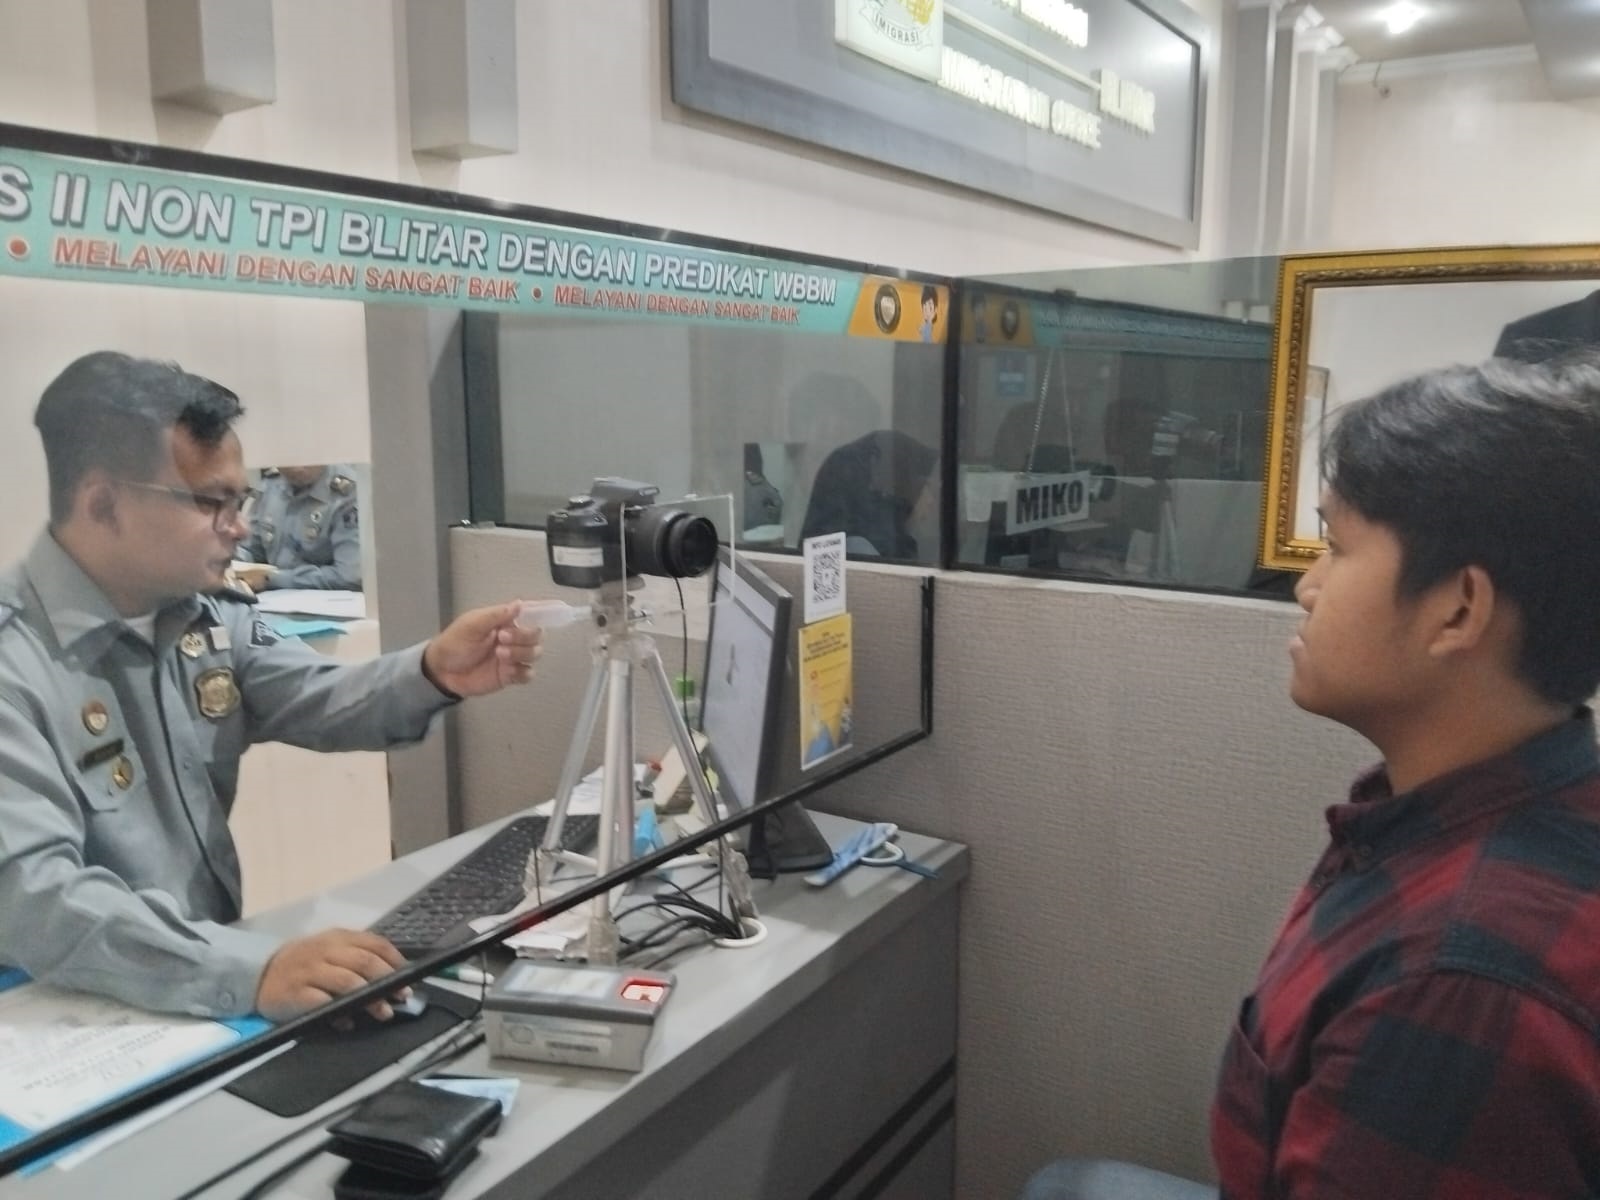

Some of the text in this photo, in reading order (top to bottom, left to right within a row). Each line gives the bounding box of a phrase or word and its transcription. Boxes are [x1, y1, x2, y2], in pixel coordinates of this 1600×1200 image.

[874, 13, 919, 42] IMIGRASI
[51, 171, 89, 227] II
[105, 179, 234, 242] NON
[250, 199, 327, 252] TPI
[340, 210, 488, 269] BLITAR
[498, 232, 637, 285] DENGAN
[644, 253, 768, 298] PREDIKAT
[773, 270, 837, 306] WBBM
[55, 237, 800, 325] MELAYANI DENGAN SANGAT BAIK MELAYANI DENGAN SANGAT BAIK
[1016, 480, 1083, 524] MIKO
